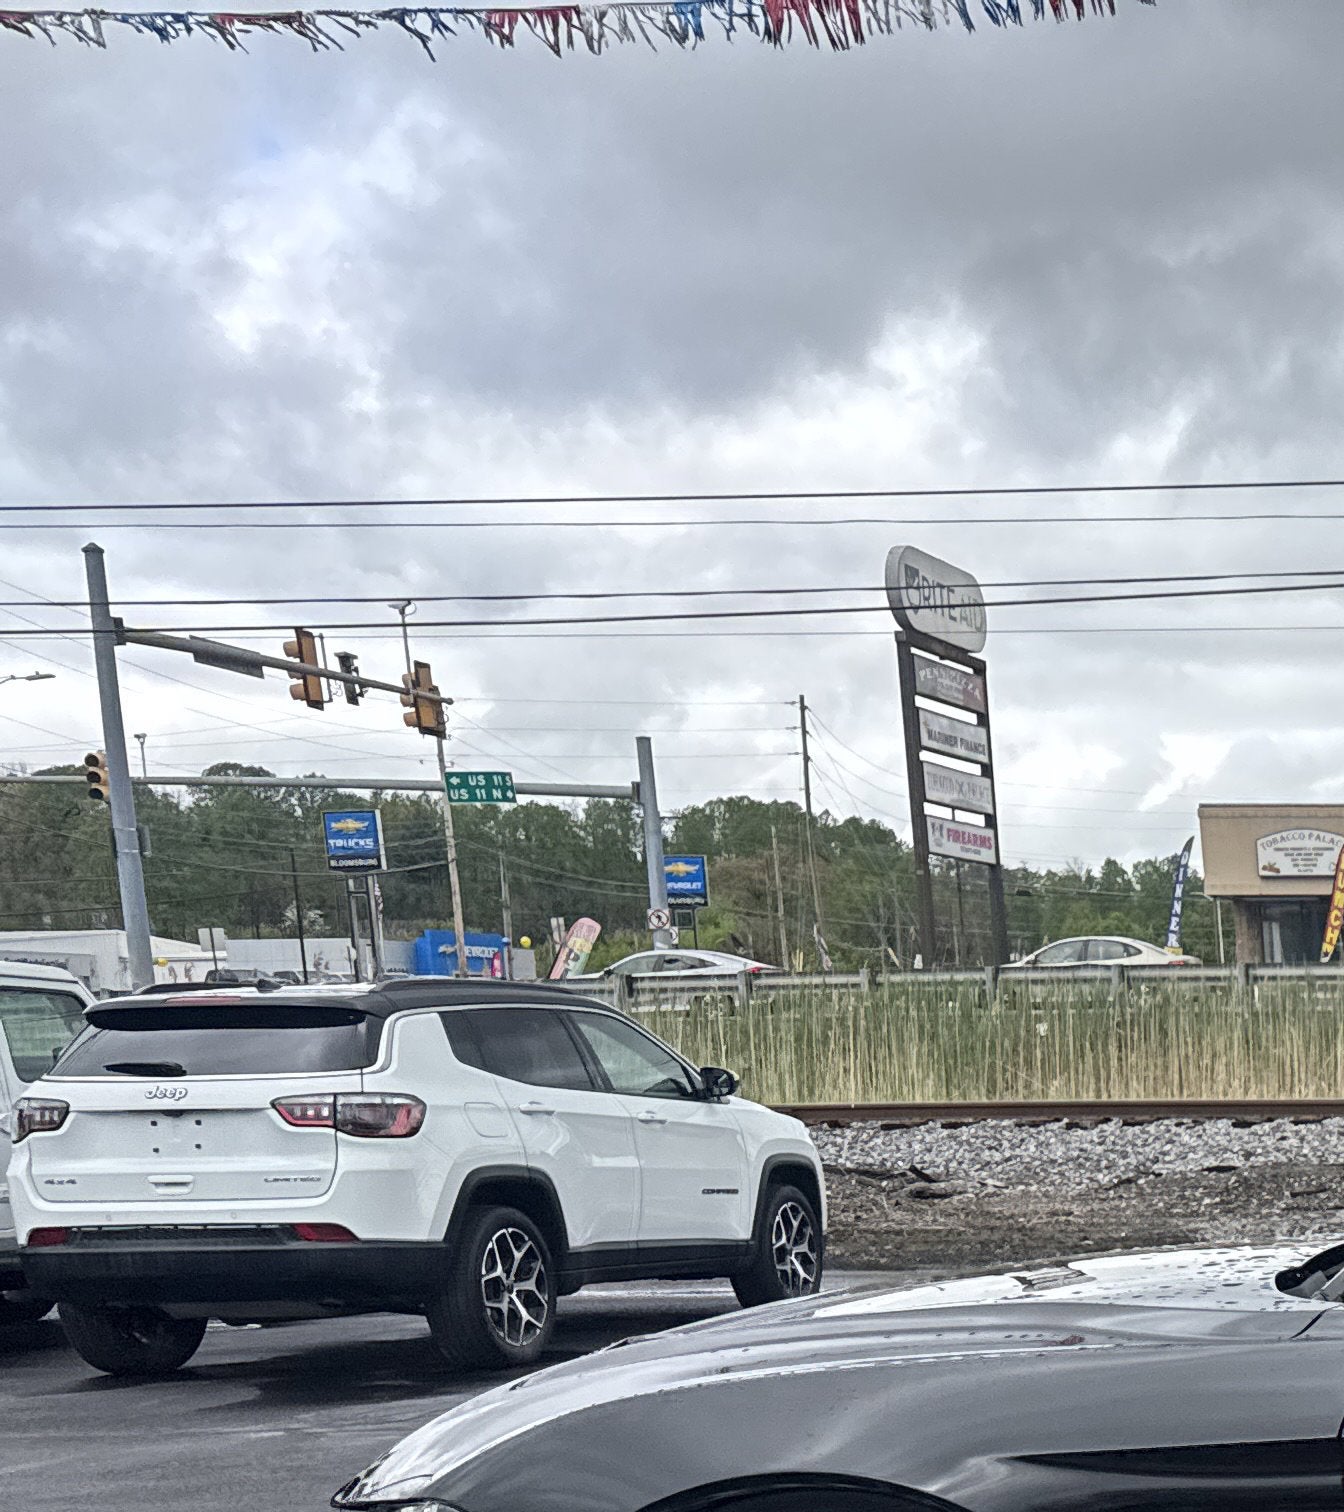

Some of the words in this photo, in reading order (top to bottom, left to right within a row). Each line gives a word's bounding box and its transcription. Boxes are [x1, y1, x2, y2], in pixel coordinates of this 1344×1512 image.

[468, 774, 486, 786] US
[493, 774, 503, 786] 11
[505, 775, 512, 787] S
[450, 788, 469, 800] US
[475, 788, 487, 800] 11
[492, 788, 502, 800] N
[328, 838, 374, 849] TRUCKS
[946, 828, 993, 851] FIREARMS
[1260, 832, 1305, 850] TOBACCO
[1308, 832, 1343, 847] PALAC
[1167, 851, 1189, 947] DINNER
[144, 1085, 188, 1101] Jeep
